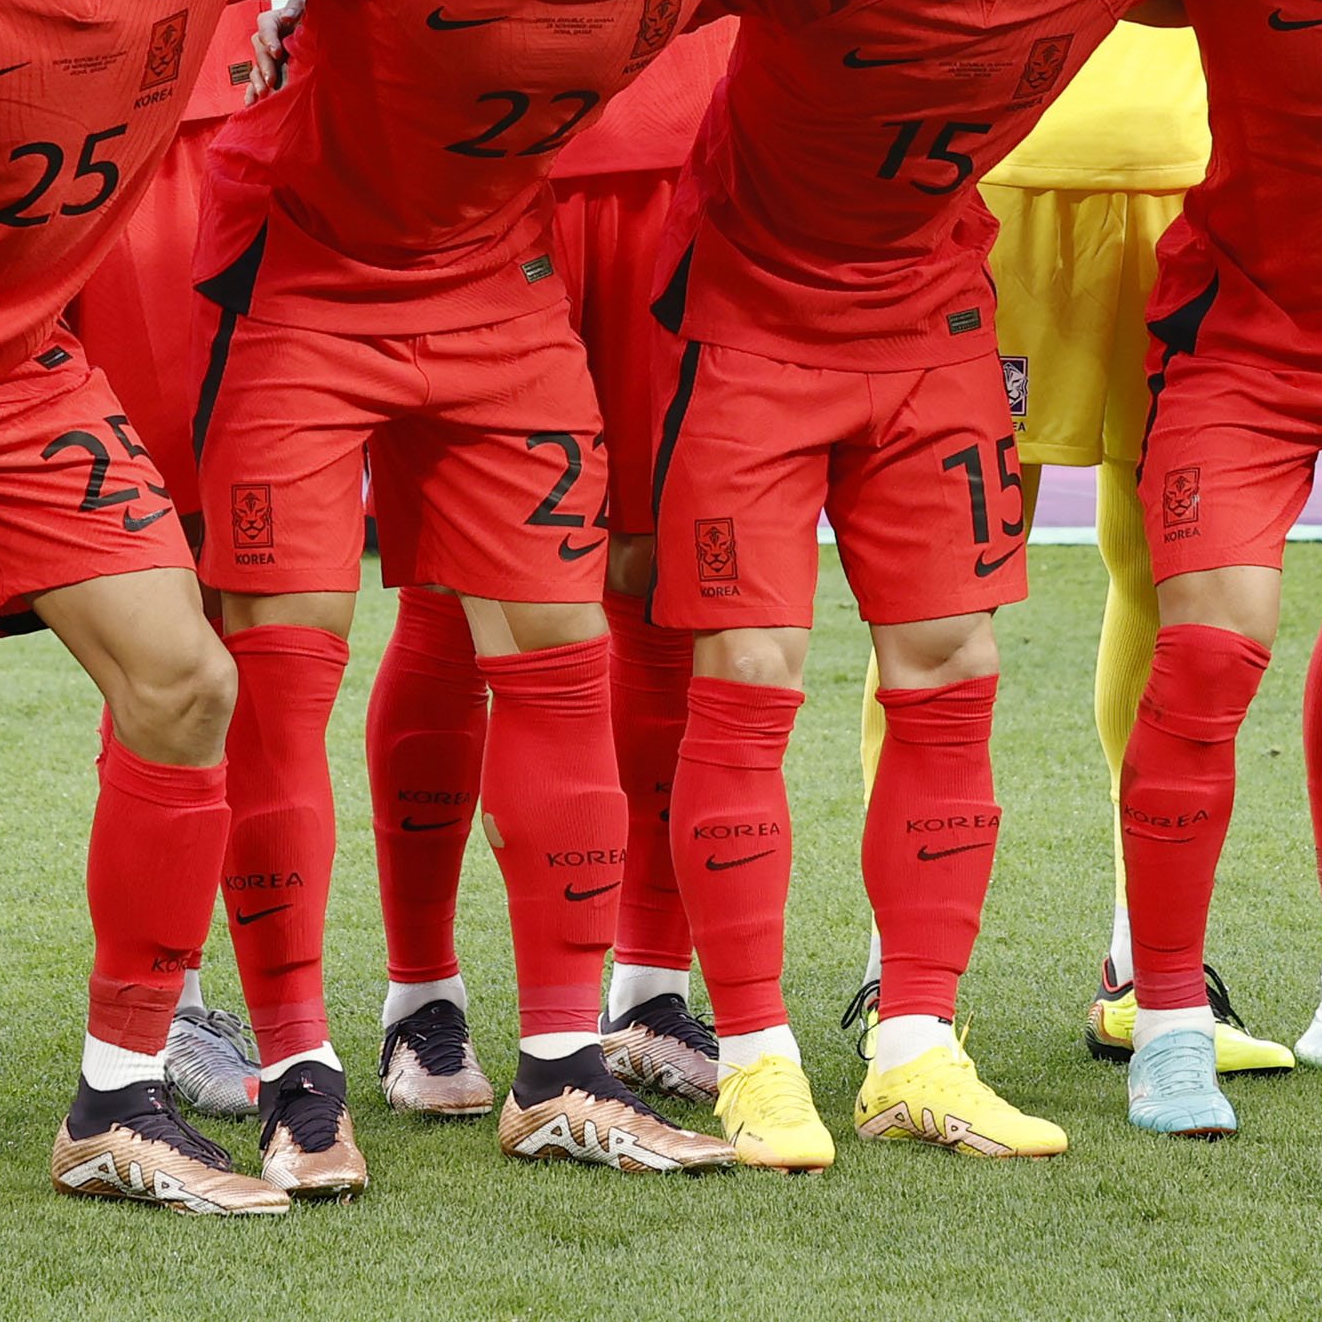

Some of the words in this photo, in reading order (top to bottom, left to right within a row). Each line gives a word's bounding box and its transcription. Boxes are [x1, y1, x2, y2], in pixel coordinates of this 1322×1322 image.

[133, 87, 173, 110] KOREA
[877, 120, 992, 196] 15
[941, 433, 1024, 545] 15
[1163, 527, 1202, 544] KOREA
[235, 552, 275, 566] KOREA
[700, 585, 741, 598] KOREA
[397, 789, 471, 806] KOREA
[906, 814, 1001, 833] KOREA
[1123, 804, 1210, 828] KOREA
[693, 821, 780, 840] KOREA
[546, 848, 628, 868] KOREA
[225, 873, 303, 892] KOREA
[152, 956, 190, 974] KOR
